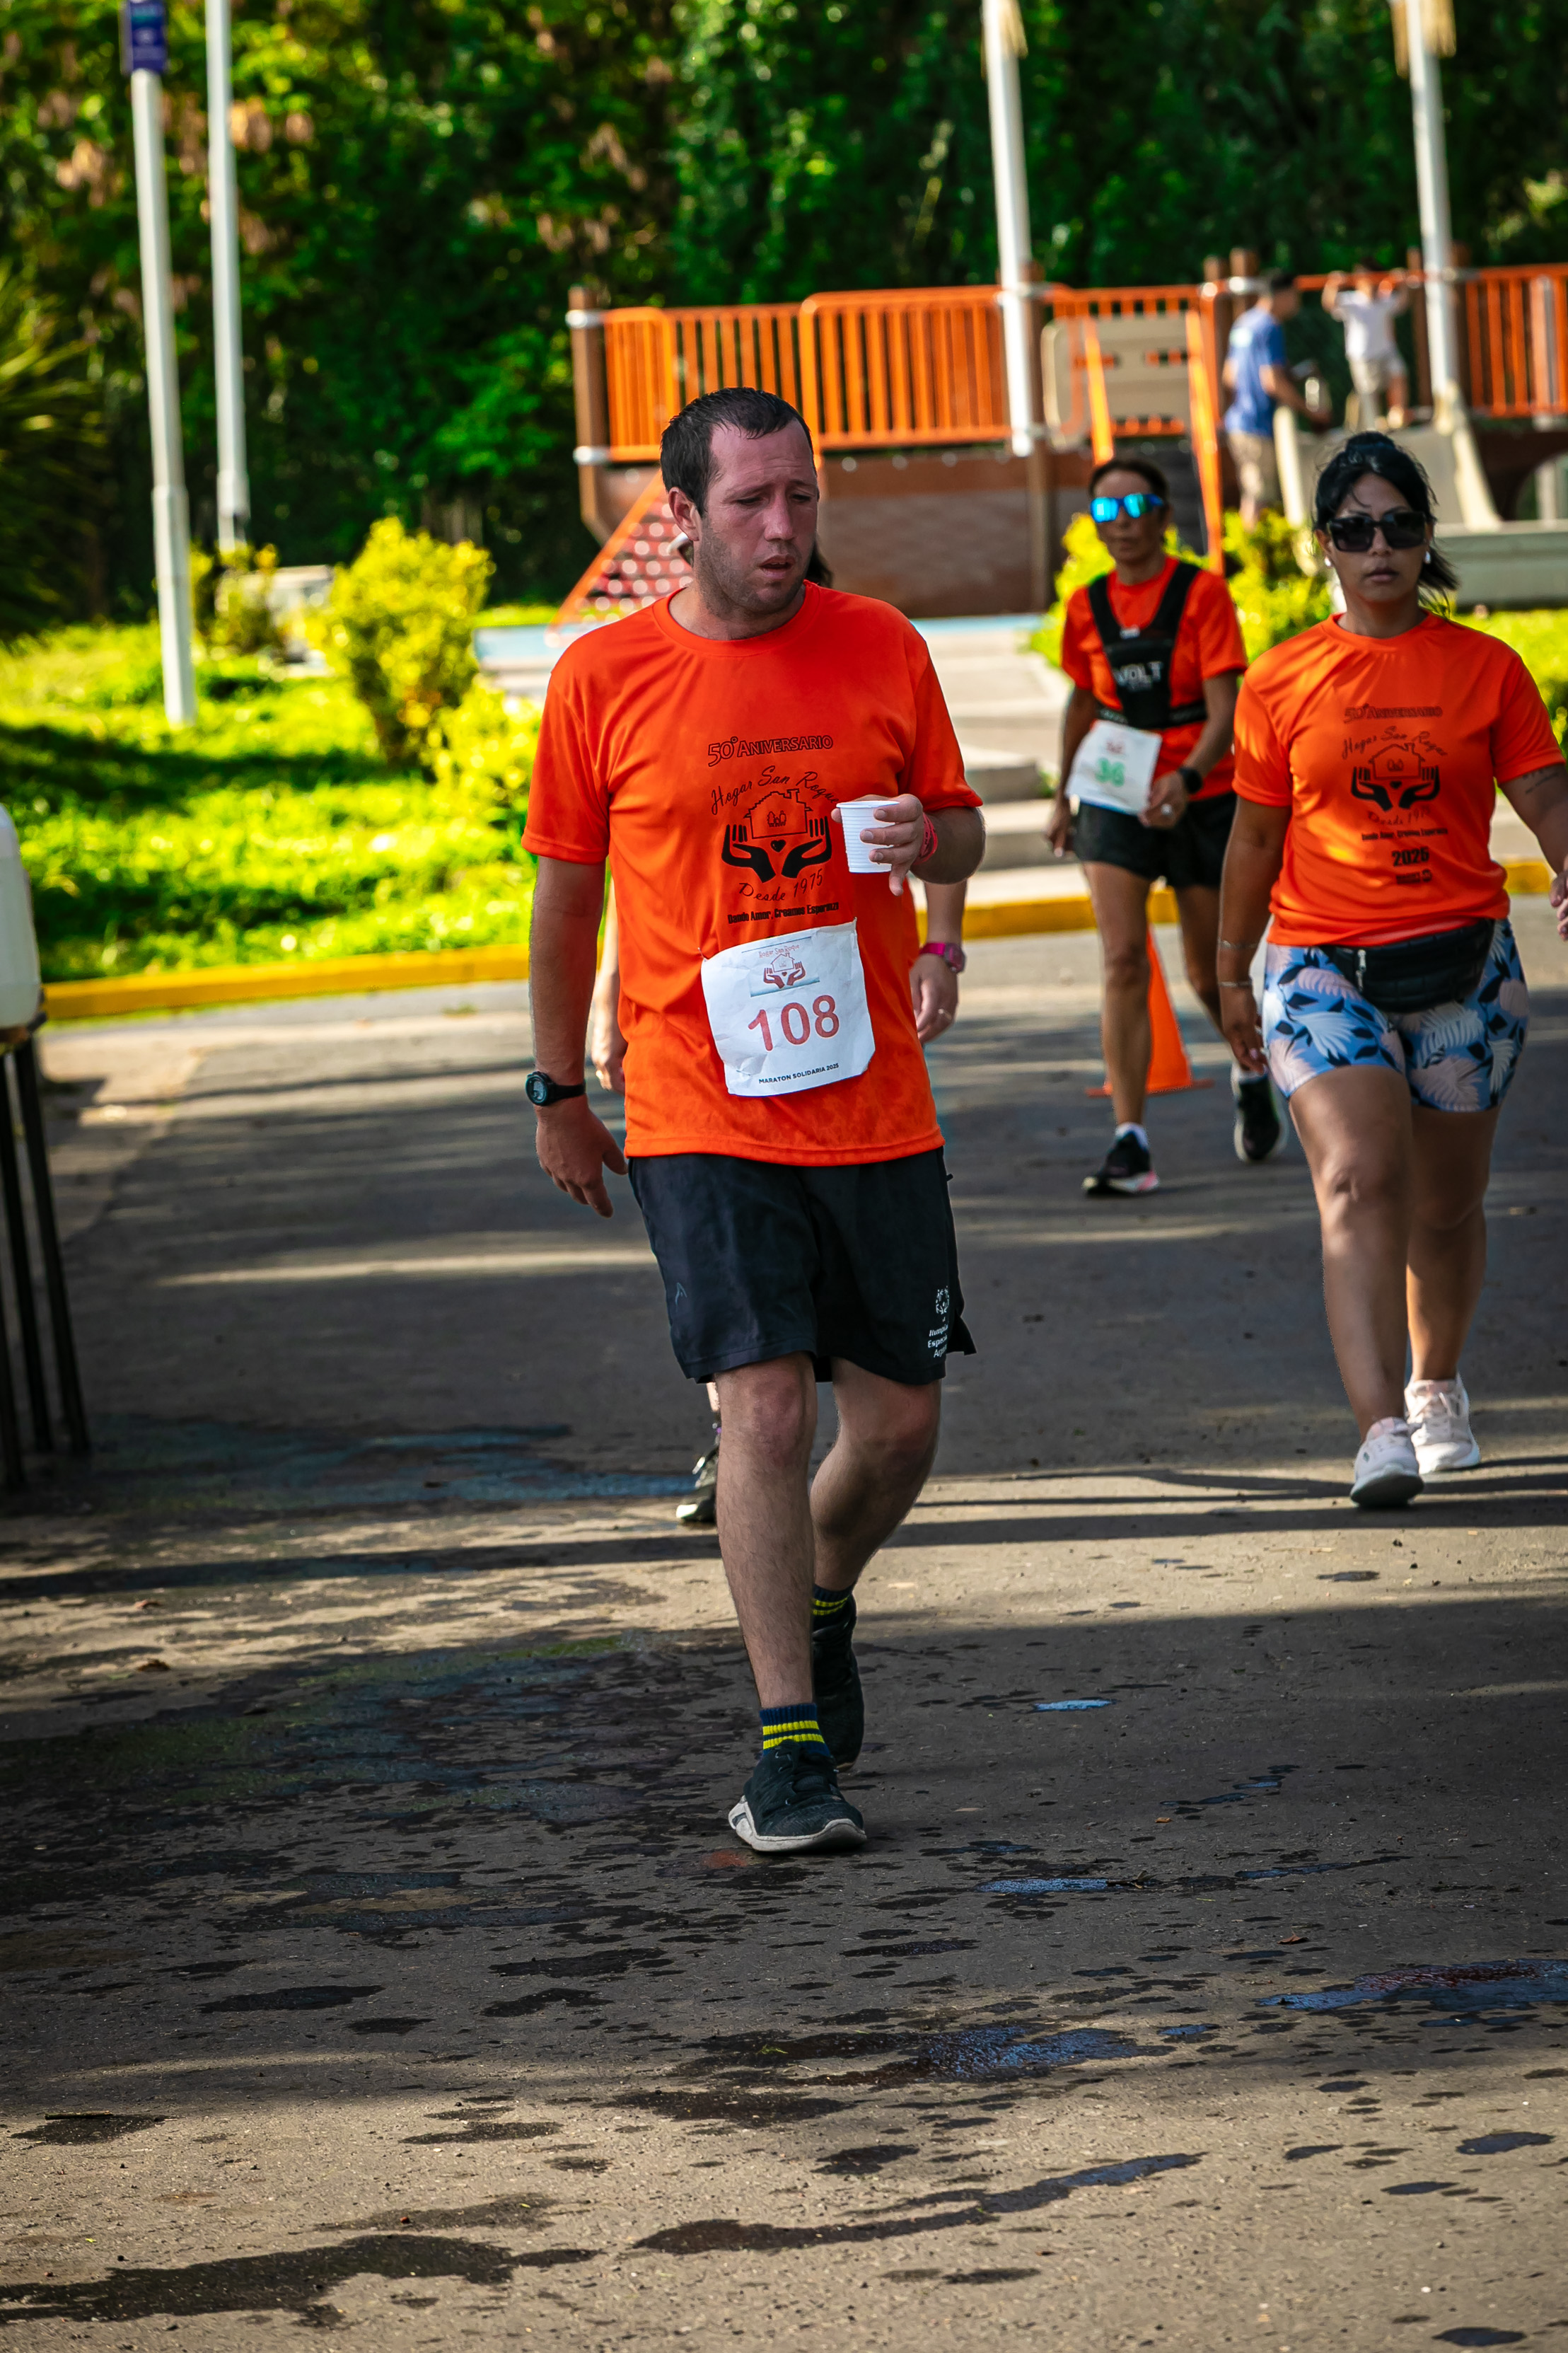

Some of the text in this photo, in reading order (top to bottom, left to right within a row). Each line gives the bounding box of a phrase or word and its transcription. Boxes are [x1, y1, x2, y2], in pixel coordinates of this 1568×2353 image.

[737, 735, 833, 758] ANIVERSARIO
[711, 765, 840, 816] Hogar San Roque
[738, 868, 823, 901] Desde 1975
[727, 912, 749, 924] Dando
[774, 906, 805, 918] Creamos
[748, 995, 840, 1052] 108
[759, 1063, 840, 1084] MARATON SOLIDARIA 2025
